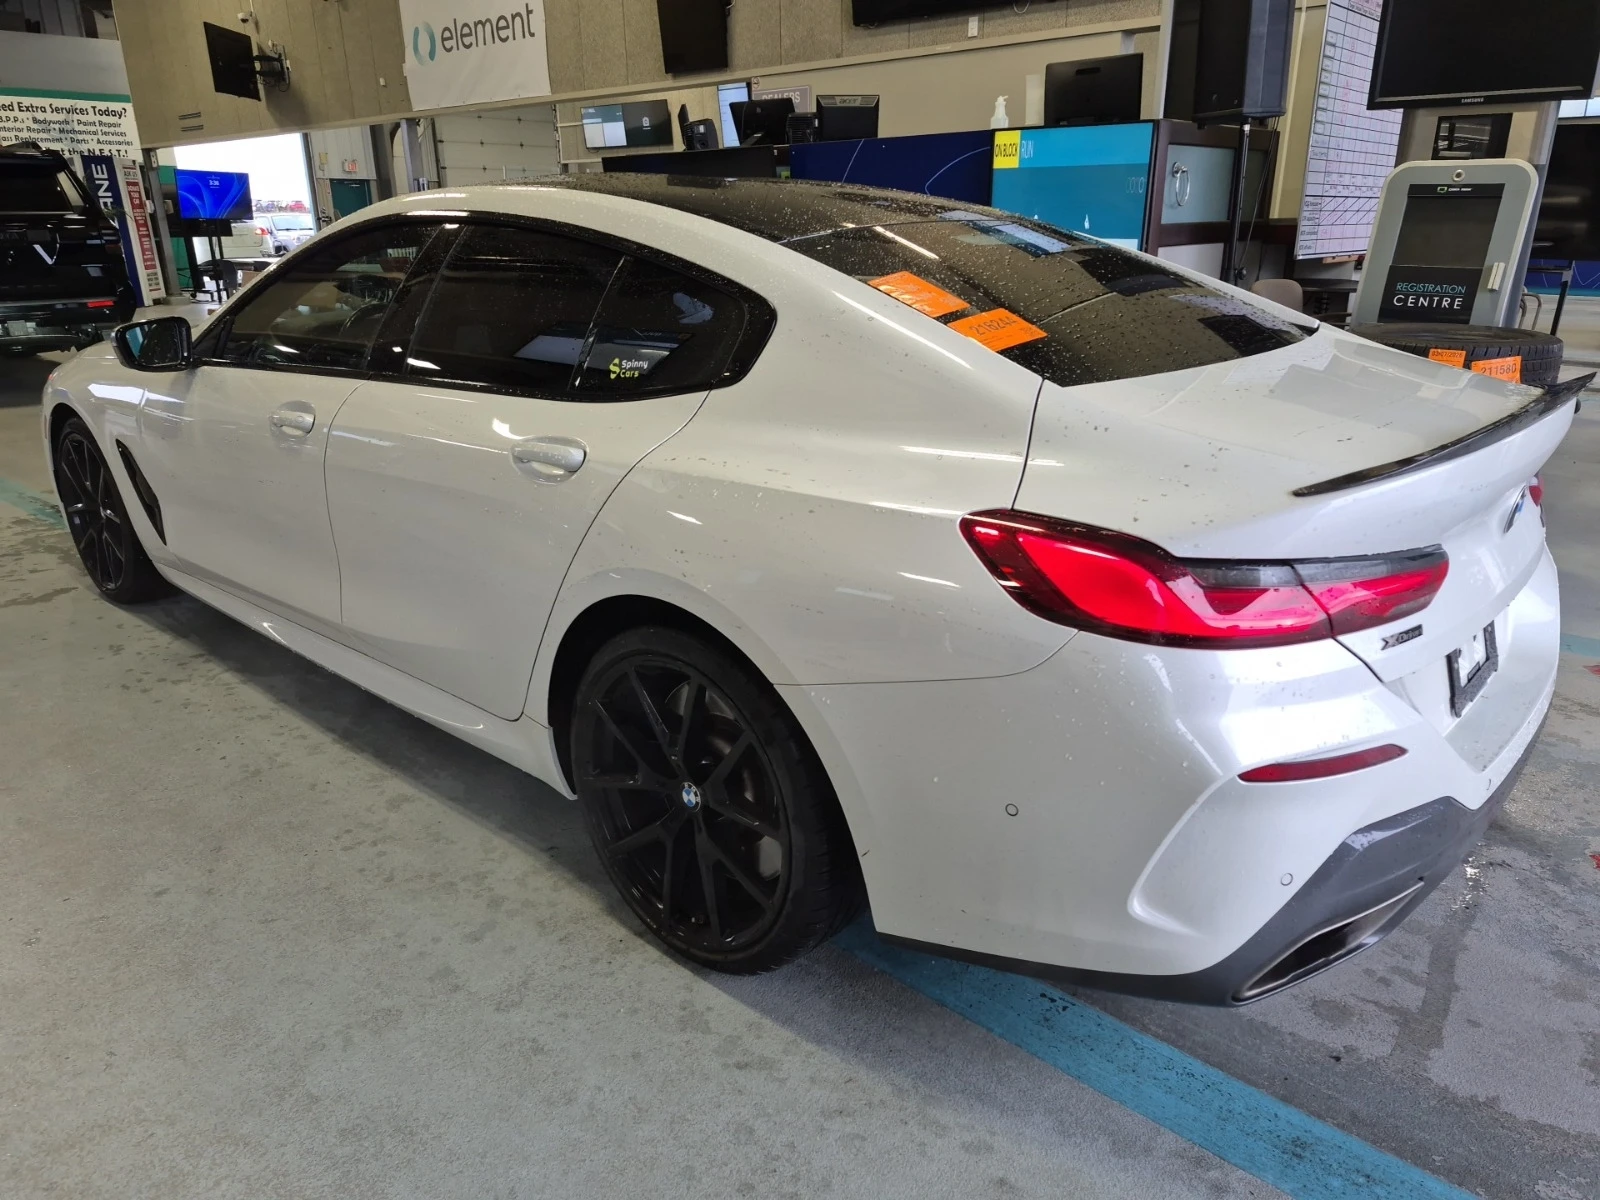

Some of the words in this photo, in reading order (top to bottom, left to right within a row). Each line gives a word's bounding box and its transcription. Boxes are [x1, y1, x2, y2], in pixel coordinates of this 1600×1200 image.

[441, 3, 535, 53] element
[0, 101, 15, 112] ed
[17, 101, 47, 113] Extra
[49, 102, 89, 115] Services
[91, 105, 127, 119] Today?
[32, 116, 70, 126] Bodywork
[77, 119, 97, 127] Paint
[98, 120, 121, 129] Repair
[0, 125, 24, 133] nterior
[26, 125, 51, 134] Repair
[59, 127, 98, 136] Mechanical
[101, 129, 127, 137] Services
[14, 134, 63, 144] Replacement
[70, 137, 89, 145] Parts
[97, 138, 133, 147] Accessories
[1395, 282, 1466, 294] REGISTRATION
[1393, 295, 1463, 309] CENTRE
[621, 359, 649, 369] Spinny
[1481, 363, 1517, 376] 211580
[620, 369, 640, 378] Cars
